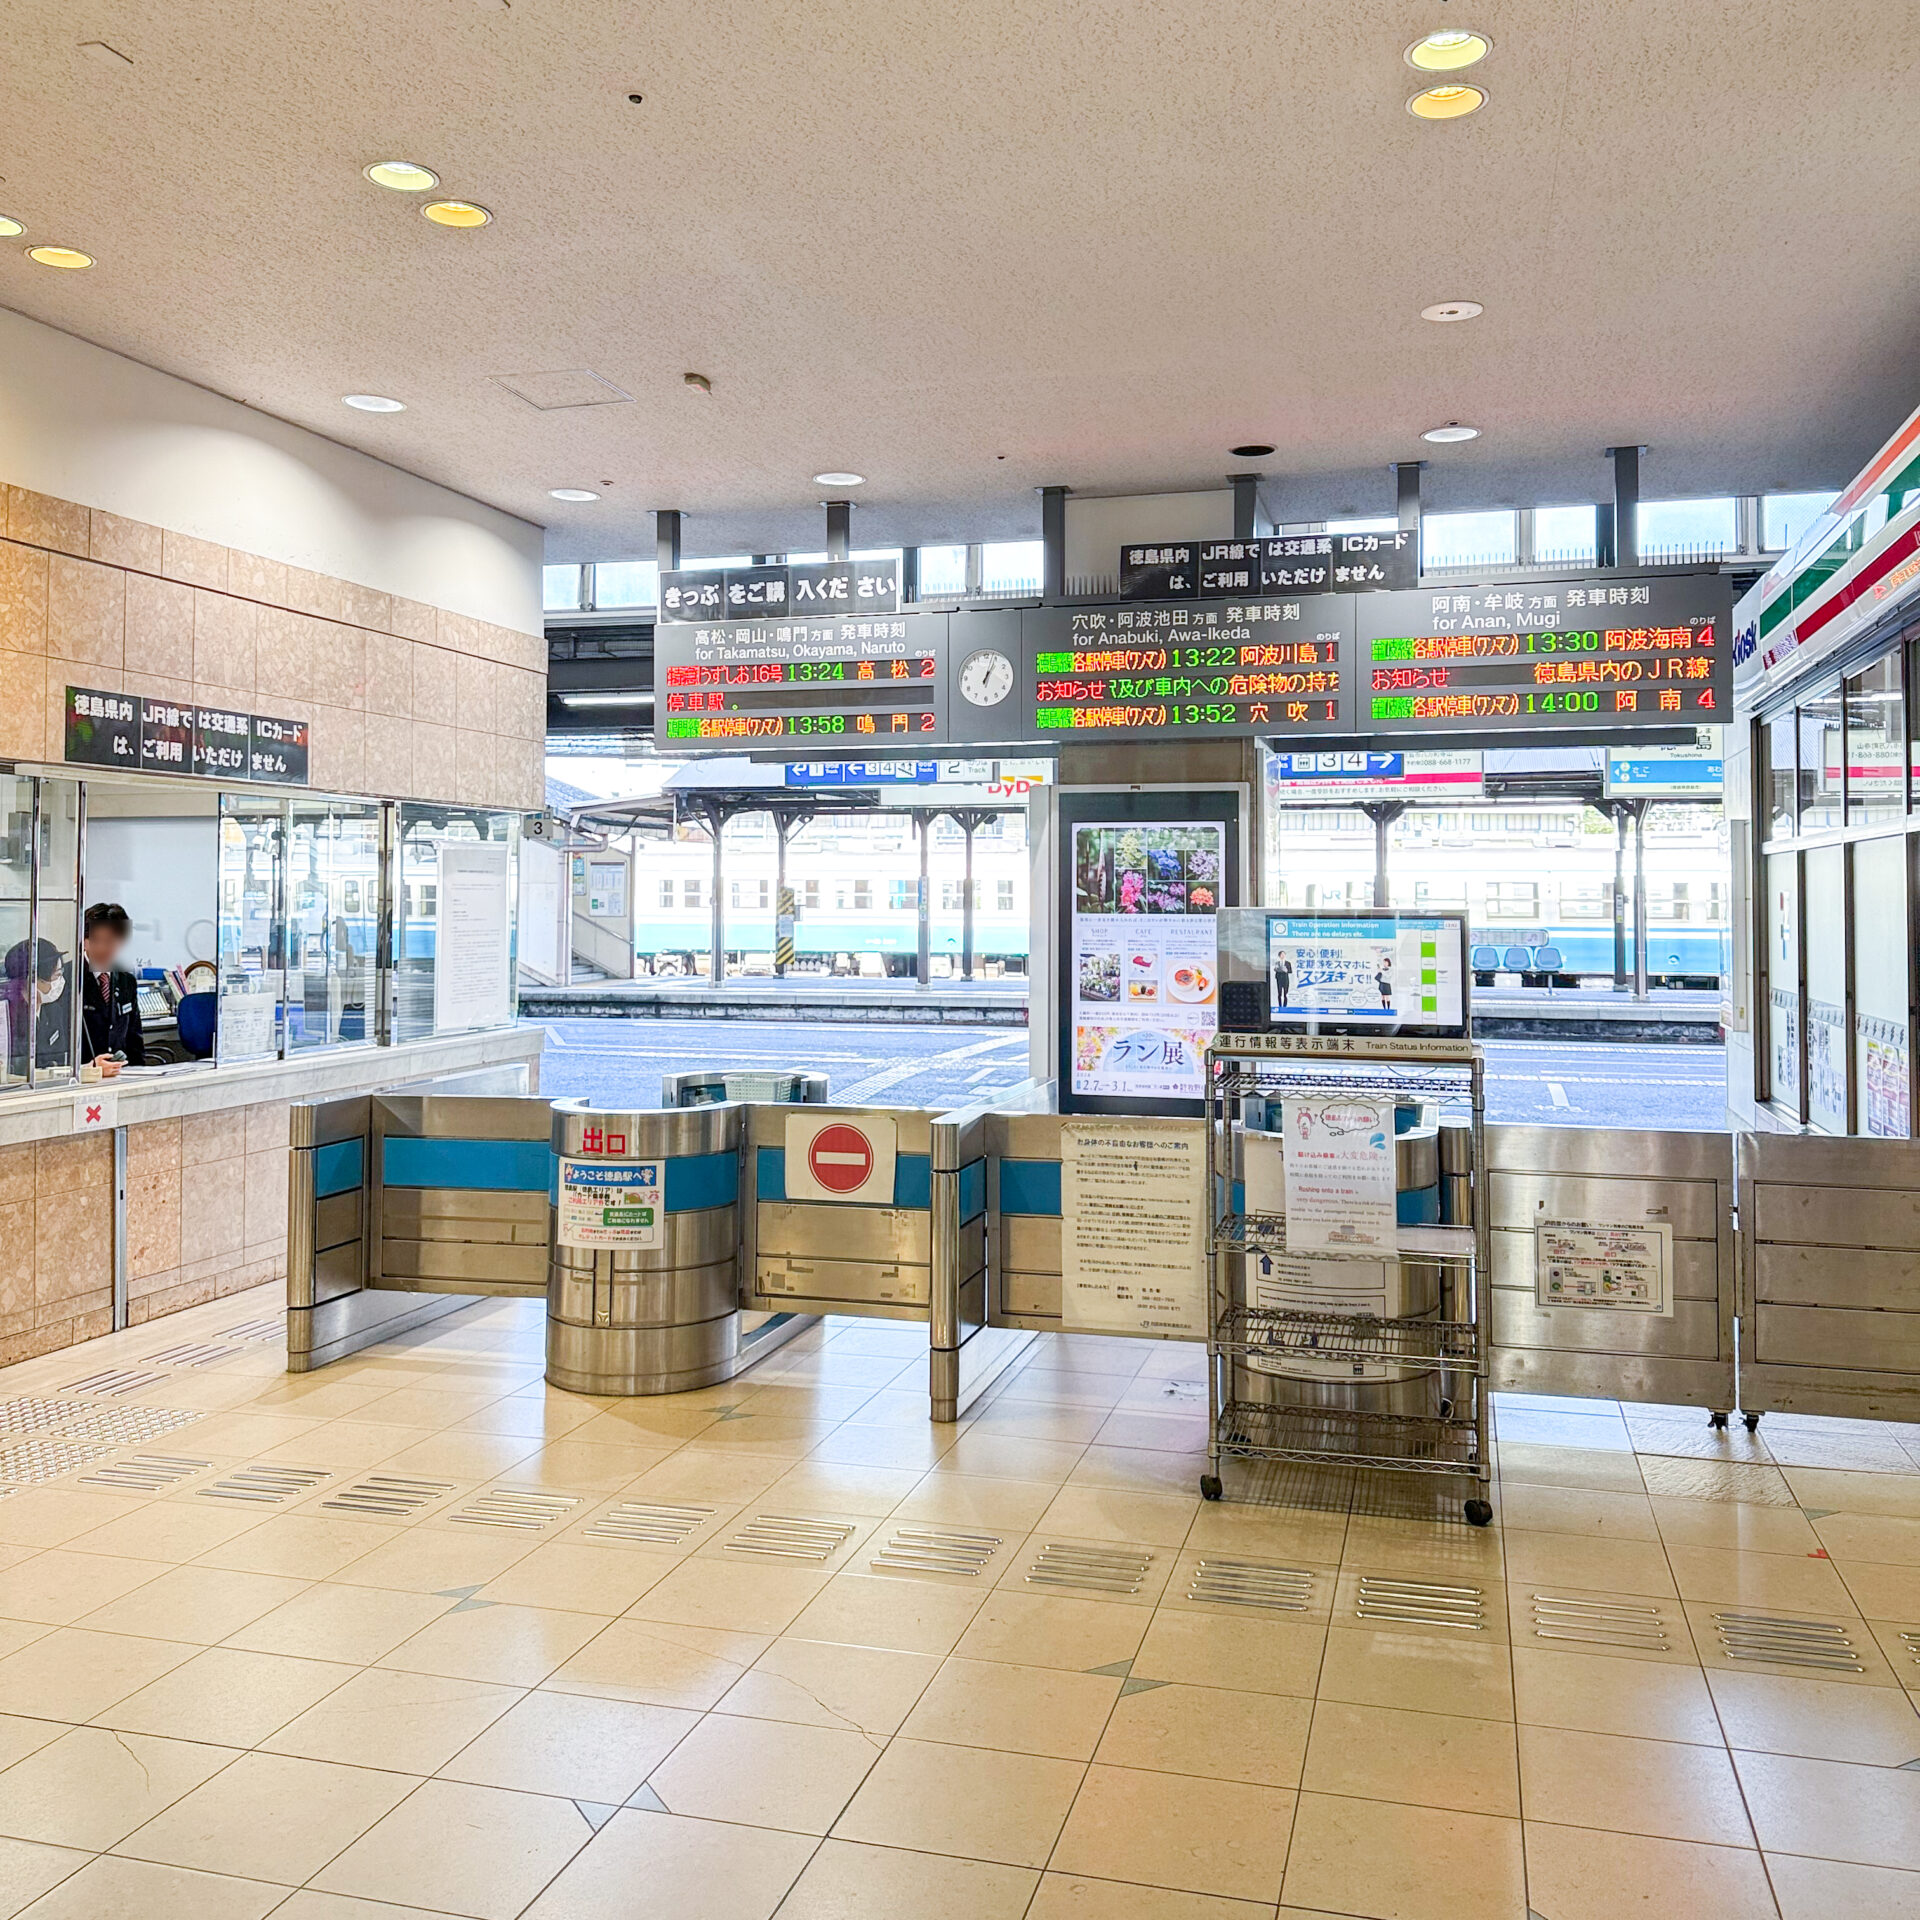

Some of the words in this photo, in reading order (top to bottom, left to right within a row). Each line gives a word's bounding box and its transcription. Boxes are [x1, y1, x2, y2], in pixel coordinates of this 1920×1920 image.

[1567, 586, 1650, 605] 発車時刻
[1226, 603, 1300, 623] 発車時刻
[1433, 615, 1457, 630] for
[1461, 613, 1511, 630] Anan,
[1516, 611, 1561, 630] Mugi
[840, 622, 906, 640] 発車時刻
[1073, 632, 1094, 646] for
[1098, 630, 1163, 646] Anabuki,
[1168, 627, 1250, 643] Awa-Ikeda
[1526, 631, 1598, 653] 13:30
[1604, 627, 1691, 651] 阿波海南
[1697, 625, 1715, 648] 4
[695, 647, 714, 660] for
[716, 645, 789, 660] Takamatsu,
[793, 643, 857, 659] Okayama,
[861, 641, 906, 655] Naruto
[1172, 647, 1236, 668] 13:22
[1240, 643, 1317, 665] 阿波川島
[1325, 643, 1336, 663] 1
[788, 662, 845, 682] 13:24
[920, 658, 936, 679] 2
[1371, 667, 1450, 690] お知らせ
[1037, 680, 1106, 701] お知らせ
[1526, 691, 1598, 713] 14:00
[1697, 688, 1715, 710] 4
[1172, 704, 1236, 724] 13:52
[1325, 701, 1336, 721] 1
[788, 715, 845, 735] 13:58
[920, 713, 936, 732] 2
[948, 761, 960, 774] 2
[1323, 753, 1336, 768] 3
[1348, 753, 1362, 767] 4
[534, 821, 543, 835] 3
[1113, 1040, 1184, 1065] ラン展
[1219, 1034, 1356, 1051] 運行情報等表示端末
[1366, 1042, 1387, 1050] Train
[1389, 1043, 1417, 1051] Status
[1419, 1044, 1468, 1052] Information
[582, 1127, 626, 1154] 出口
[572, 1169, 642, 1182] ようこそ徳島駅へ
